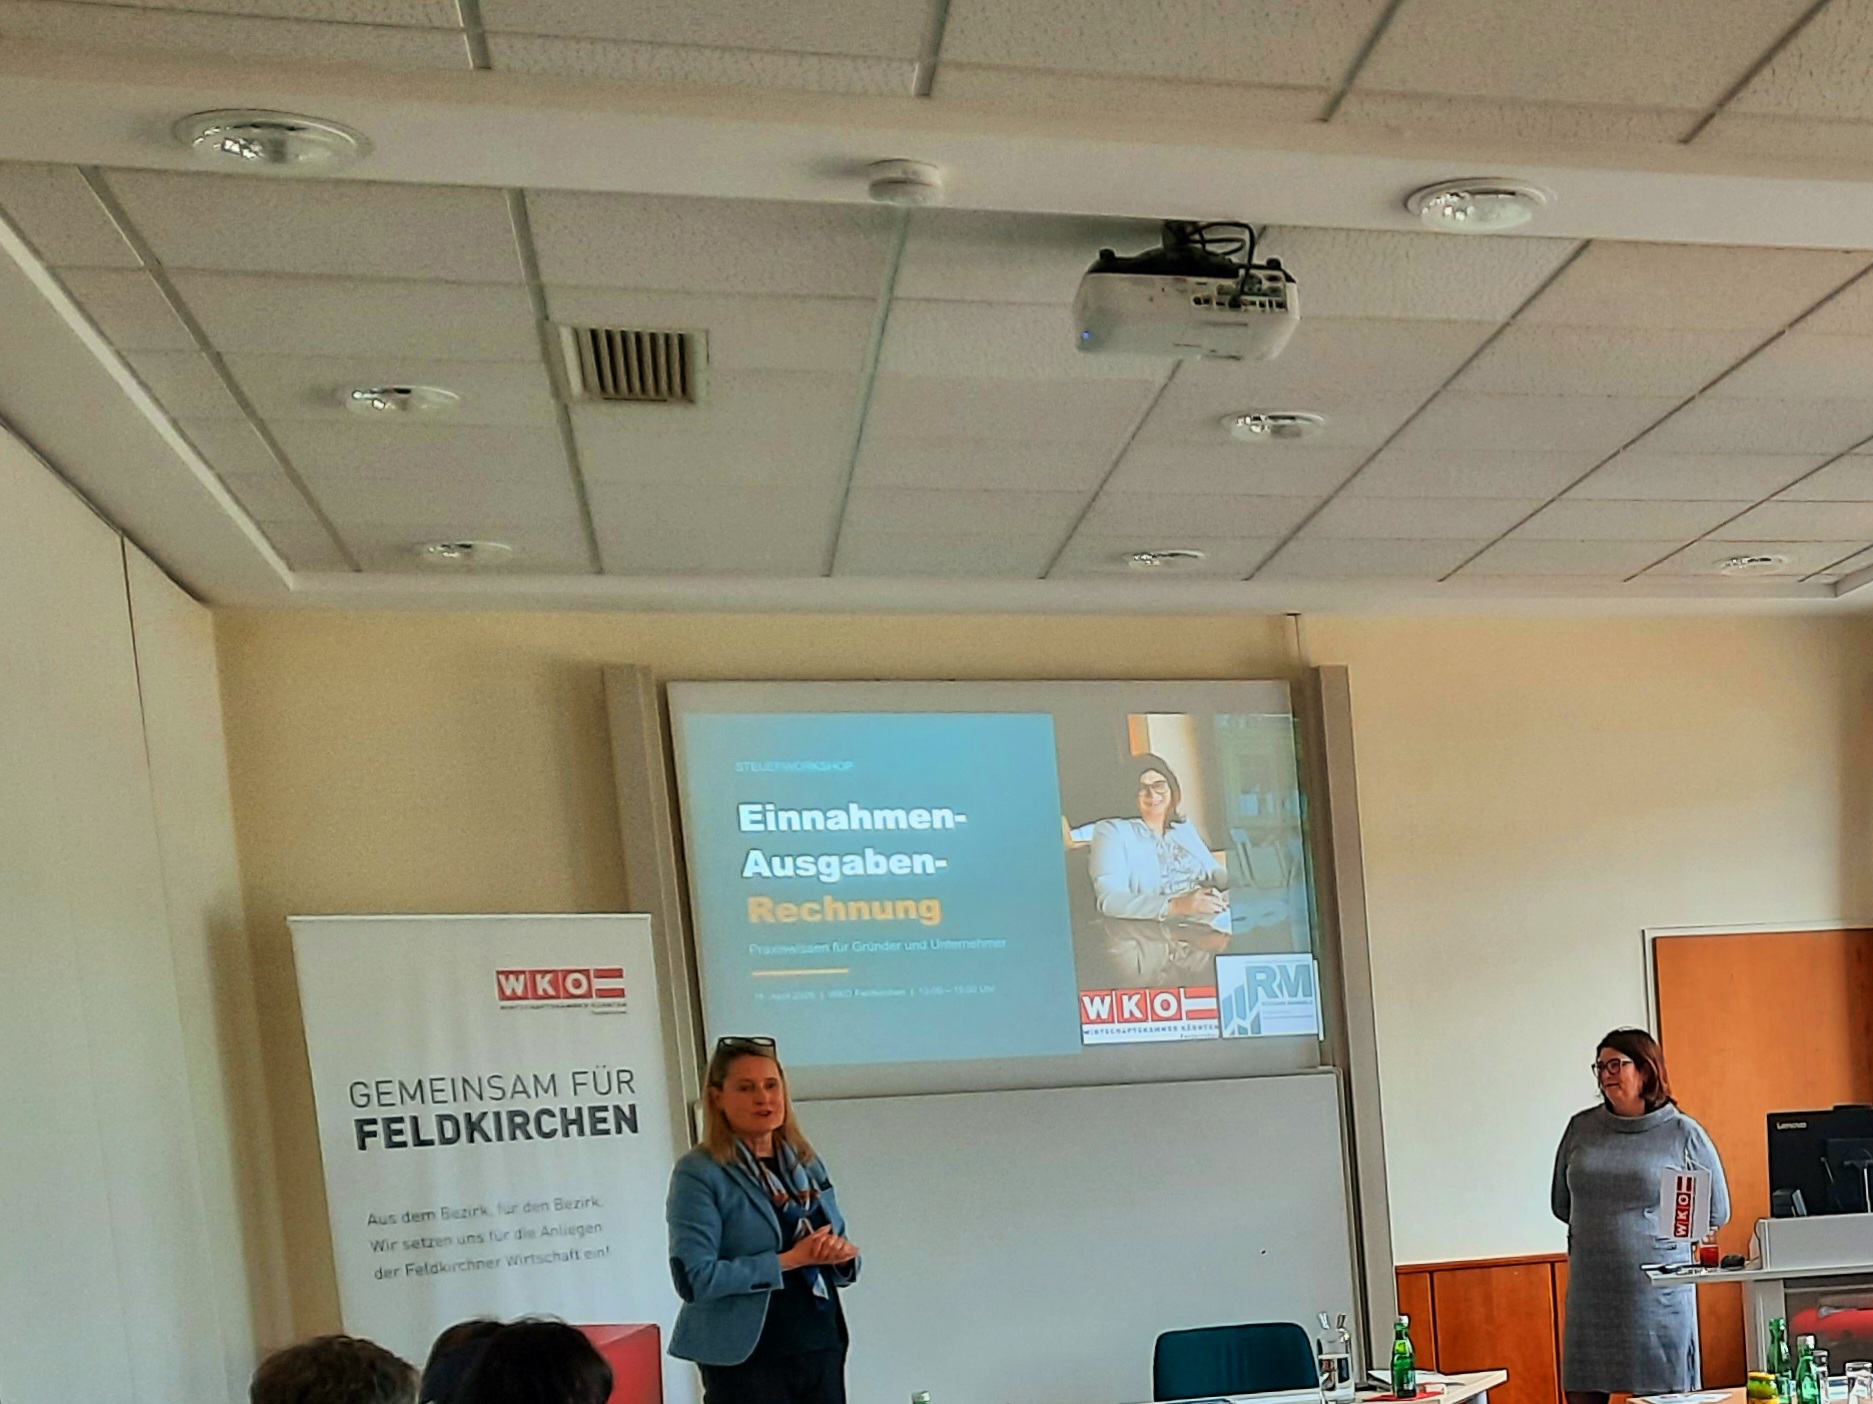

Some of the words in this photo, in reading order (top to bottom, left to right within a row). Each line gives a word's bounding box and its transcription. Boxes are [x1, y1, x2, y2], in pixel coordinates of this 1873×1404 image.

[737, 802, 967, 832] Einnahmen-
[741, 848, 948, 882] Ausgaben-
[747, 895, 942, 926] Rechnung
[852, 938, 902, 952] Gründer
[904, 938, 928, 951] und
[930, 937, 1007, 950] Unternehmer
[498, 972, 589, 997] WKO
[1245, 964, 1313, 1000] RM
[1081, 992, 1179, 1020] WKO
[349, 1073, 557, 1108] GEMEINSAM
[571, 1065, 635, 1097] FÜR
[354, 1104, 640, 1151] FELDKIRCHEN
[367, 1212, 397, 1227] Aus
[401, 1208, 436, 1224] dem
[523, 1199, 550, 1213] den
[1675, 1193, 1690, 1237] WKO
[370, 1238, 399, 1253] Wir
[403, 1235, 452, 1251] setzen
[456, 1232, 485, 1246] uns
[515, 1226, 537, 1241] die
[540, 1222, 603, 1239] Anliegen
[374, 1265, 400, 1280] der
[405, 1257, 501, 1277] Feldkirchner
[506, 1249, 579, 1268] Wirtschaft
